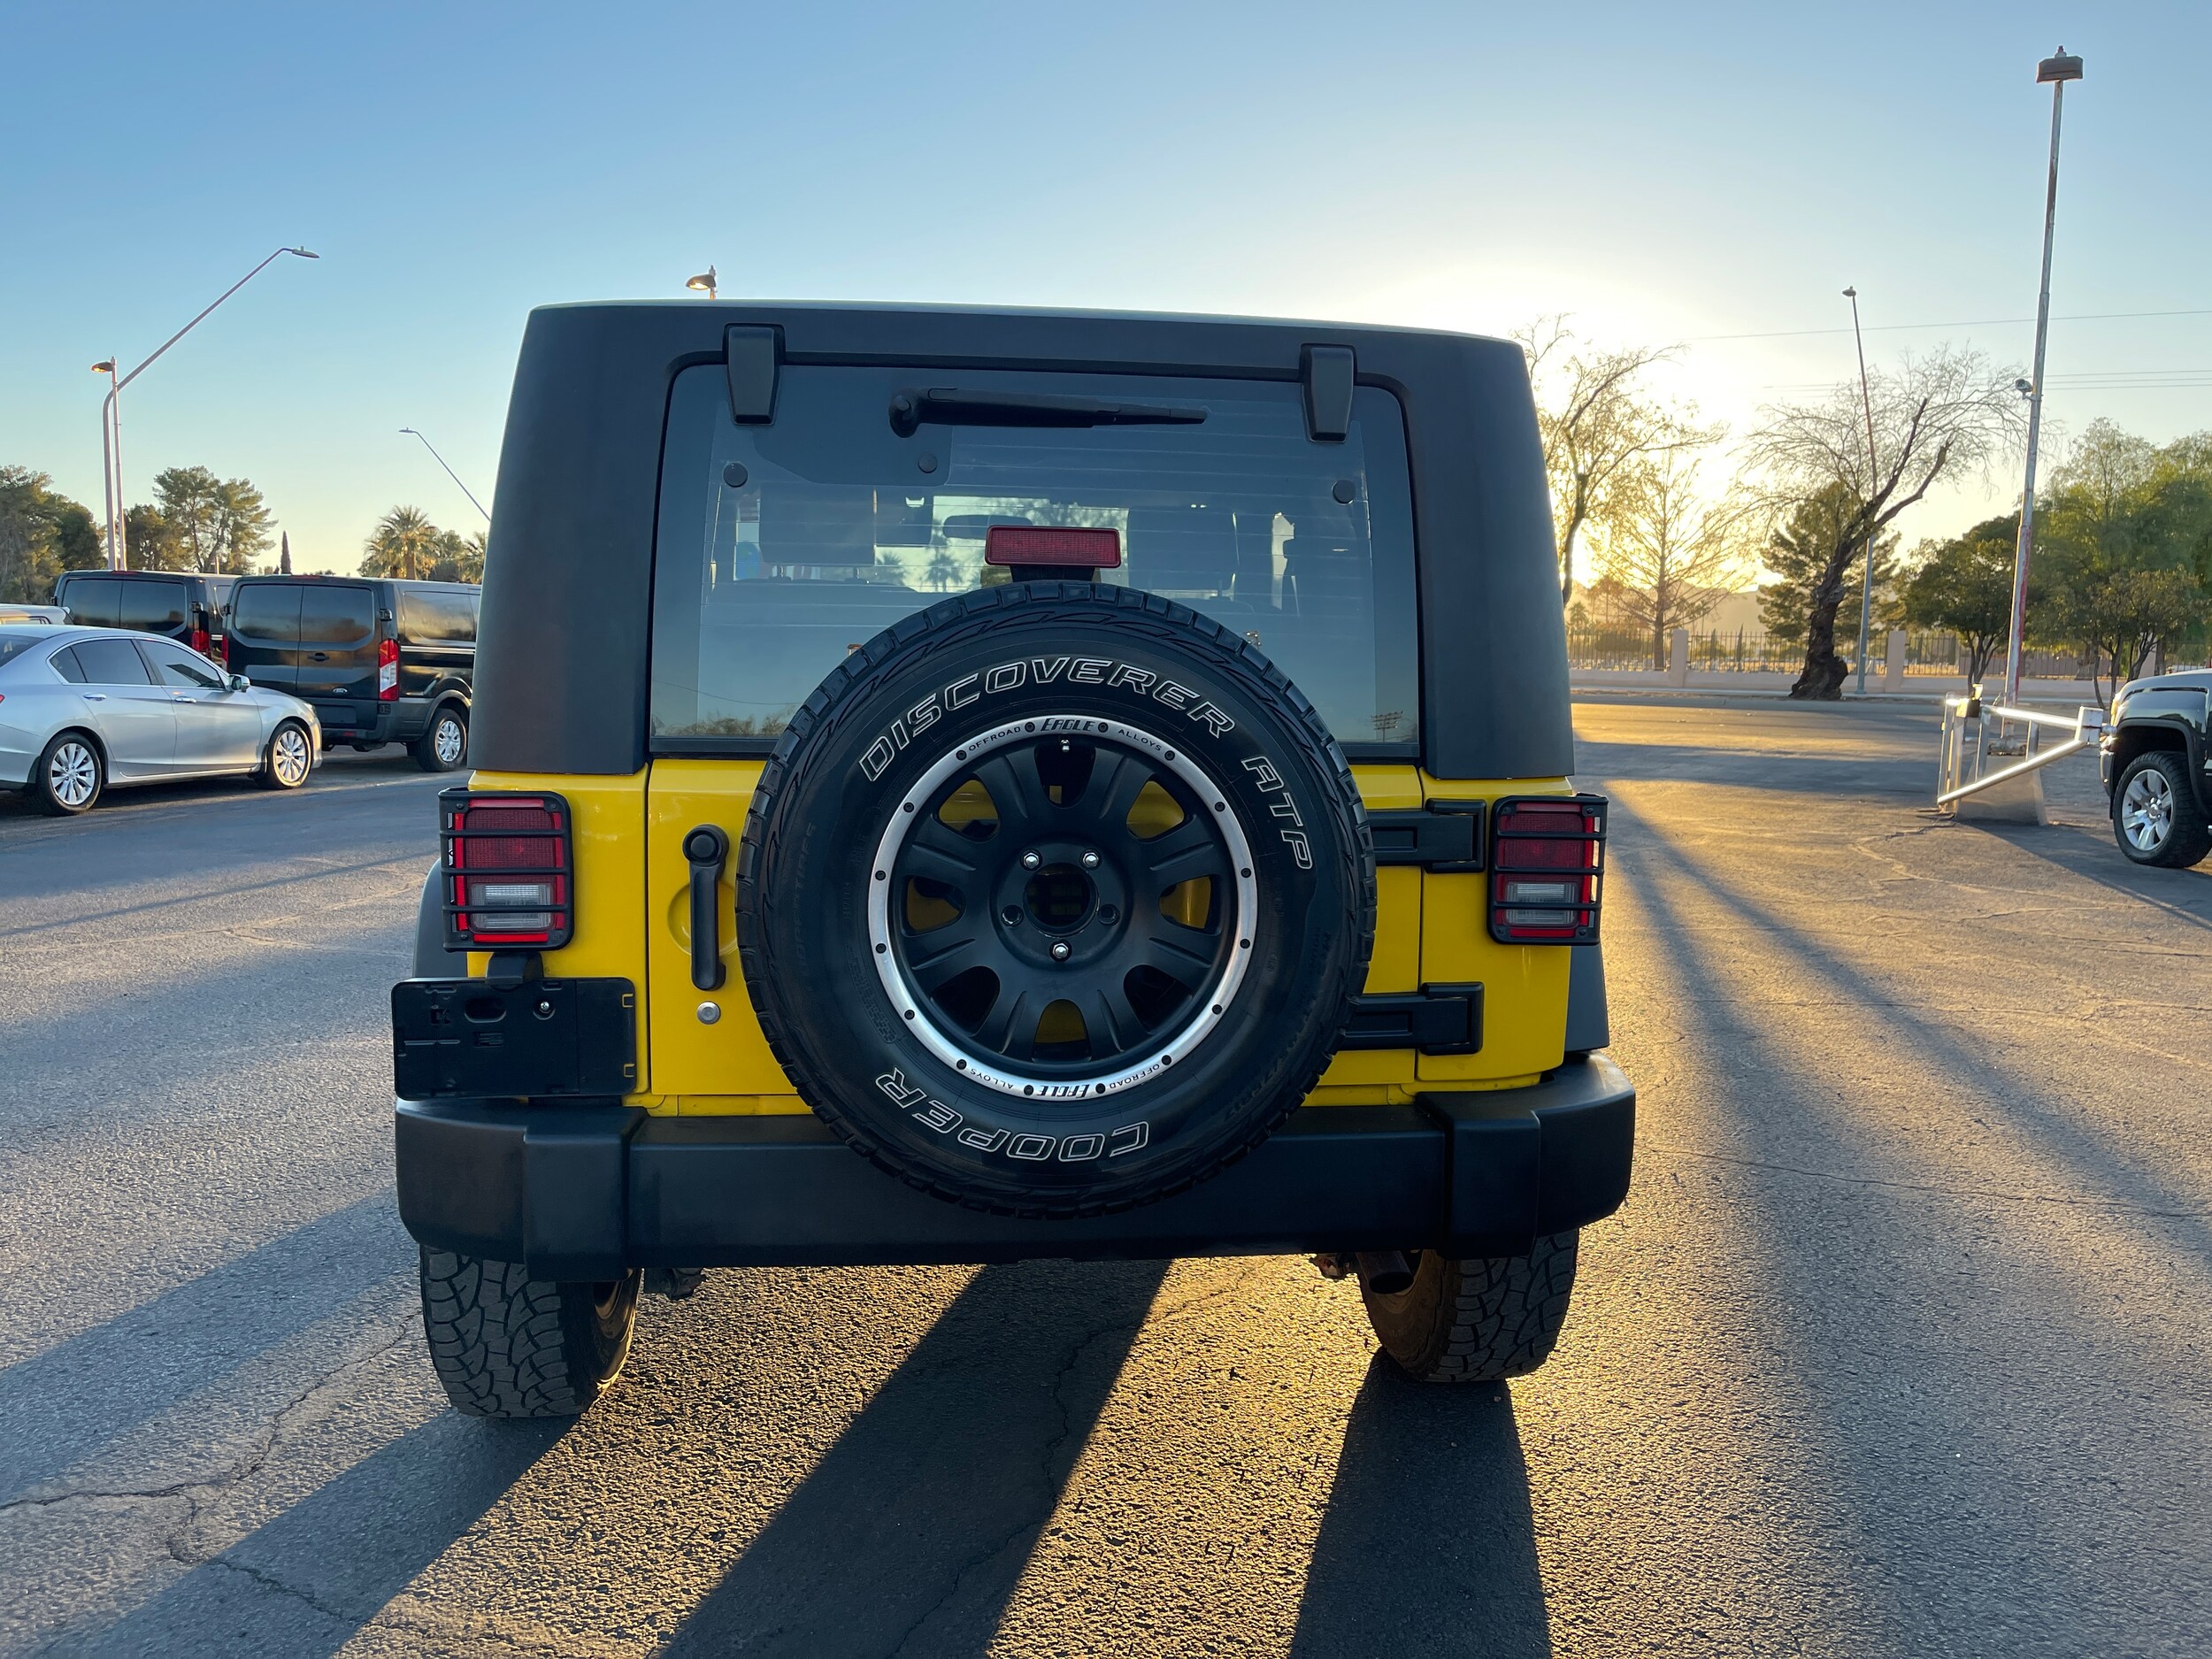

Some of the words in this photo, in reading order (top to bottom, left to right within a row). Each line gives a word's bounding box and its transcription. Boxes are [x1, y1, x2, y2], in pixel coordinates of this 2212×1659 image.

[969, 726, 1021, 751] OFFROAD
[1040, 718, 1095, 732] EAGLE
[1118, 728, 1162, 752] ALLOYS
[857, 657, 1236, 782] DISCOVERER
[1241, 756, 1315, 871] ATP
[971, 1068, 1013, 1089] ALLOYS
[1109, 1064, 1160, 1088] OFFROAD
[1037, 1084, 1090, 1098] EAGLE
[875, 1066, 1149, 1162] COOPER
